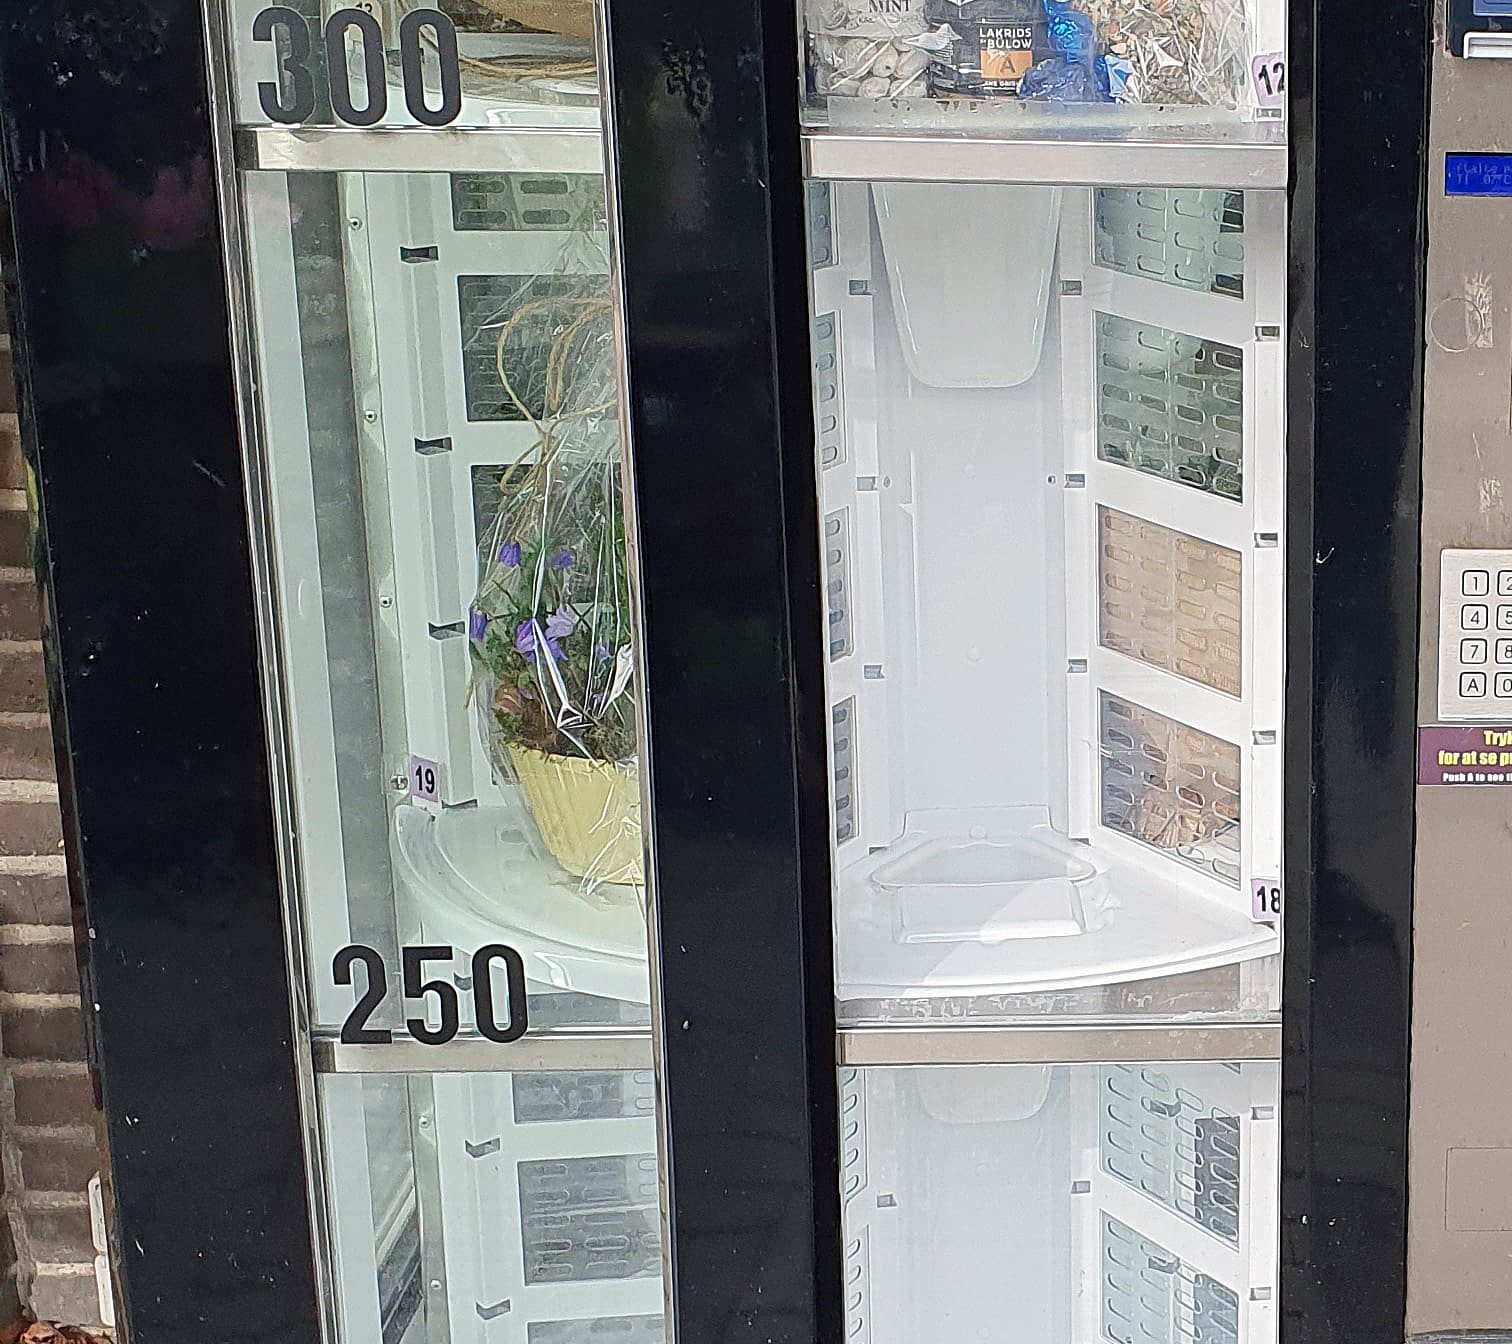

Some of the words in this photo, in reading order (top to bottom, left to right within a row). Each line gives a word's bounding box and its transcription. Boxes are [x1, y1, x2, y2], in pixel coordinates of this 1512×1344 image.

[979, 27, 1032, 39] LAKRIDS
[252, 6, 462, 126] 300
[1258, 62, 1285, 95] 12
[1472, 575, 1479, 591] 1
[1469, 610, 1481, 625] 4
[1470, 644, 1479, 659] 7
[1466, 678, 1479, 692] A
[1502, 678, 1512, 693] 0
[1437, 749, 1460, 765] for
[1461, 750, 1478, 765] at
[1479, 752, 1497, 765] se
[415, 765, 435, 794] 19
[1442, 772, 1466, 782] Push
[1467, 772, 1474, 782] A
[1475, 773, 1485, 782] to
[1487, 774, 1504, 782] see
[1256, 885, 1281, 914] 18
[332, 943, 529, 1046] 250
